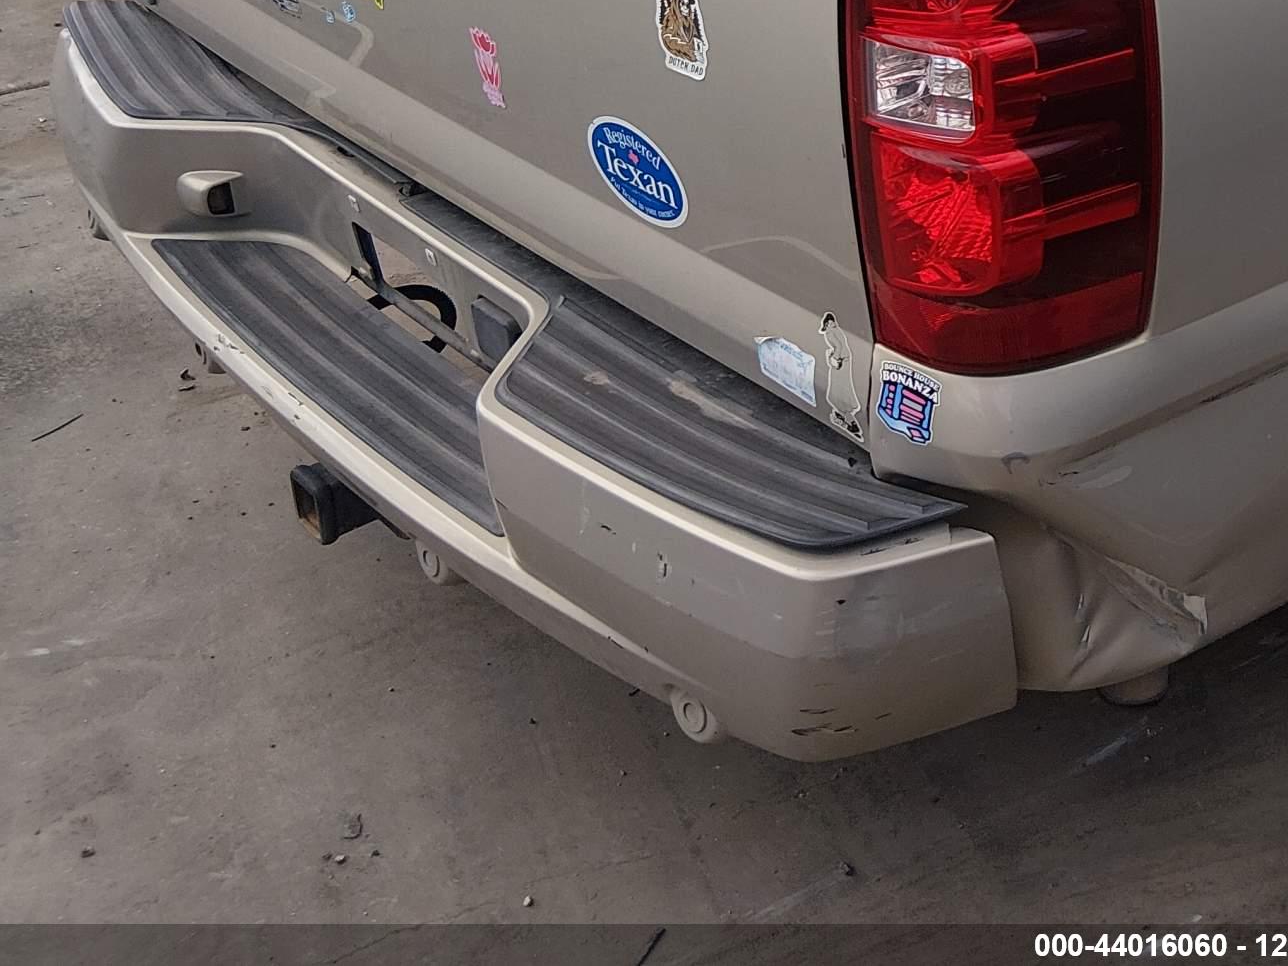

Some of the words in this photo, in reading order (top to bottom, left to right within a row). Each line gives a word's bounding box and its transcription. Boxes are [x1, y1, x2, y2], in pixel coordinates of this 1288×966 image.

[668, 55, 689, 72] DUTCH
[691, 64, 704, 76] DAD
[603, 127, 661, 170] Registered
[597, 139, 678, 210] Texan
[882, 370, 939, 404] BONANZA
[884, 363, 913, 377] BOUNCE
[914, 372, 940, 392] HOUSE
